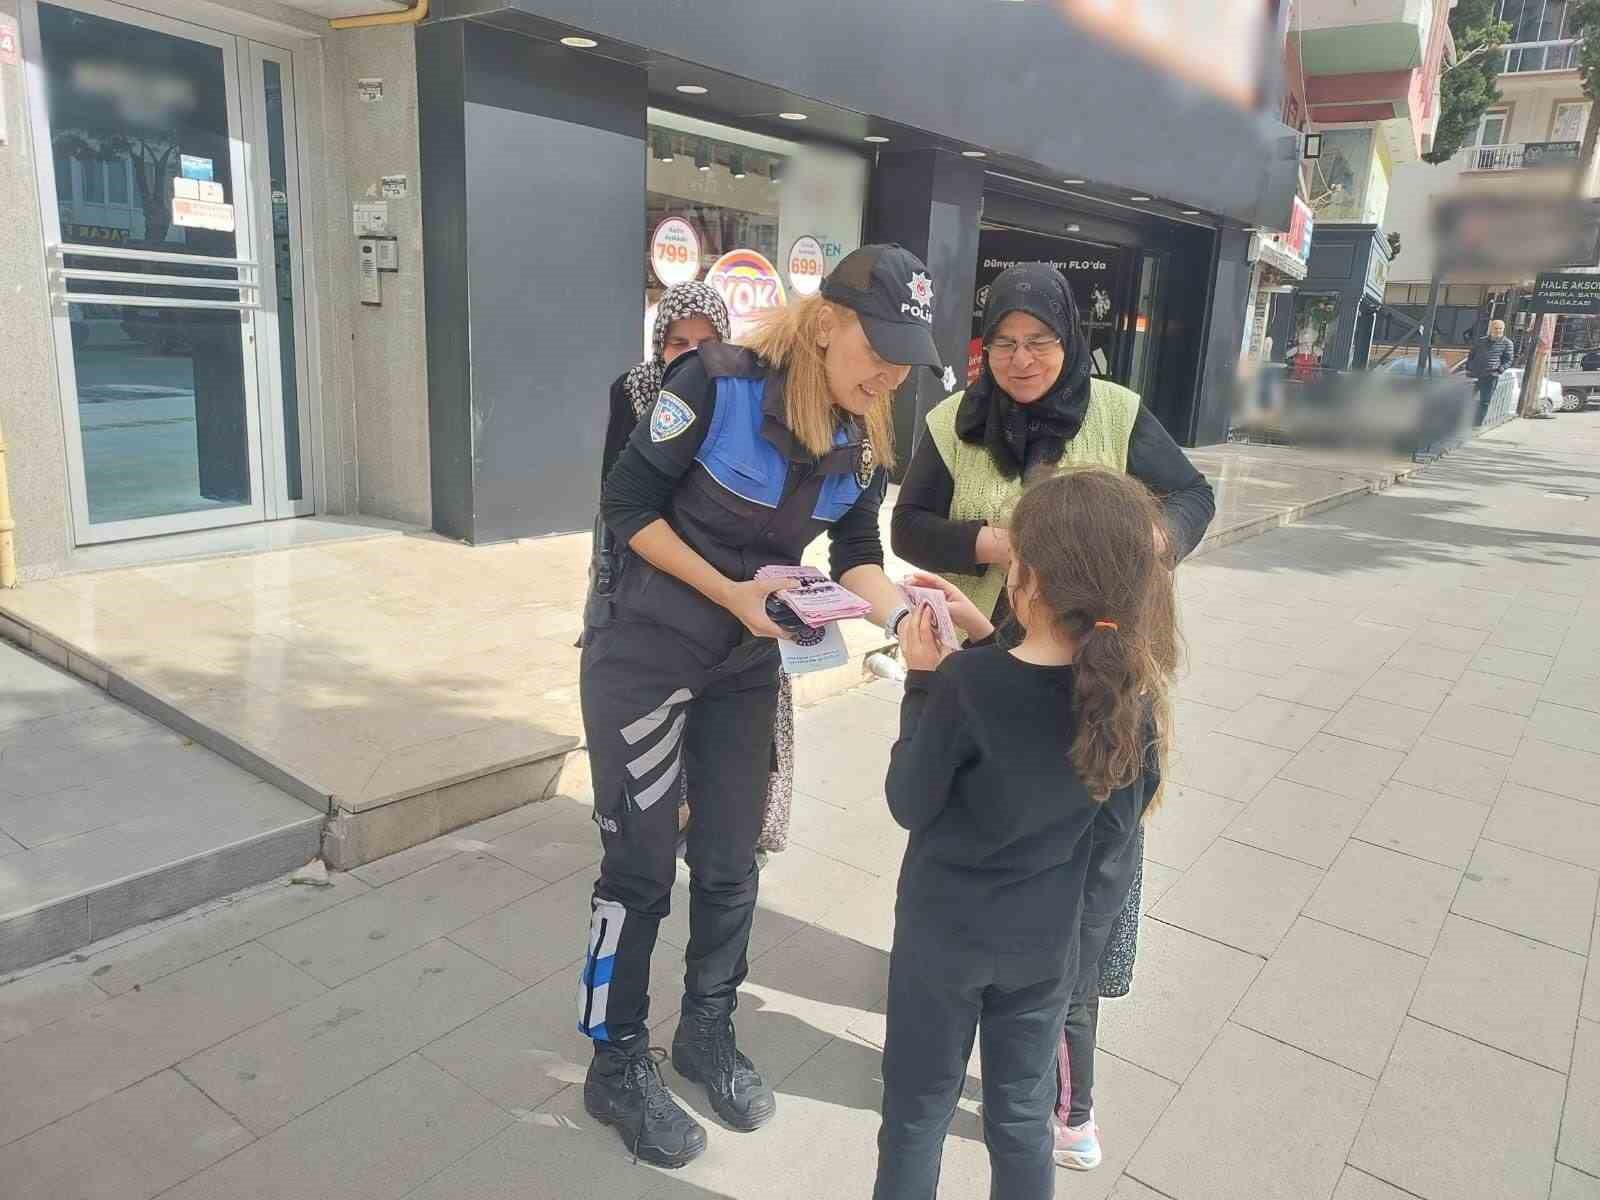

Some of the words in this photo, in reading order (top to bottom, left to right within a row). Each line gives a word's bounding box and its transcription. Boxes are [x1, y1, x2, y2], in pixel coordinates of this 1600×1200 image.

[656, 243, 688, 264] 799
[791, 256, 817, 275] 699
[983, 259, 1014, 270] Dünya
[1069, 261, 1106, 270] FLO'da
[1541, 280, 1569, 289] HALE
